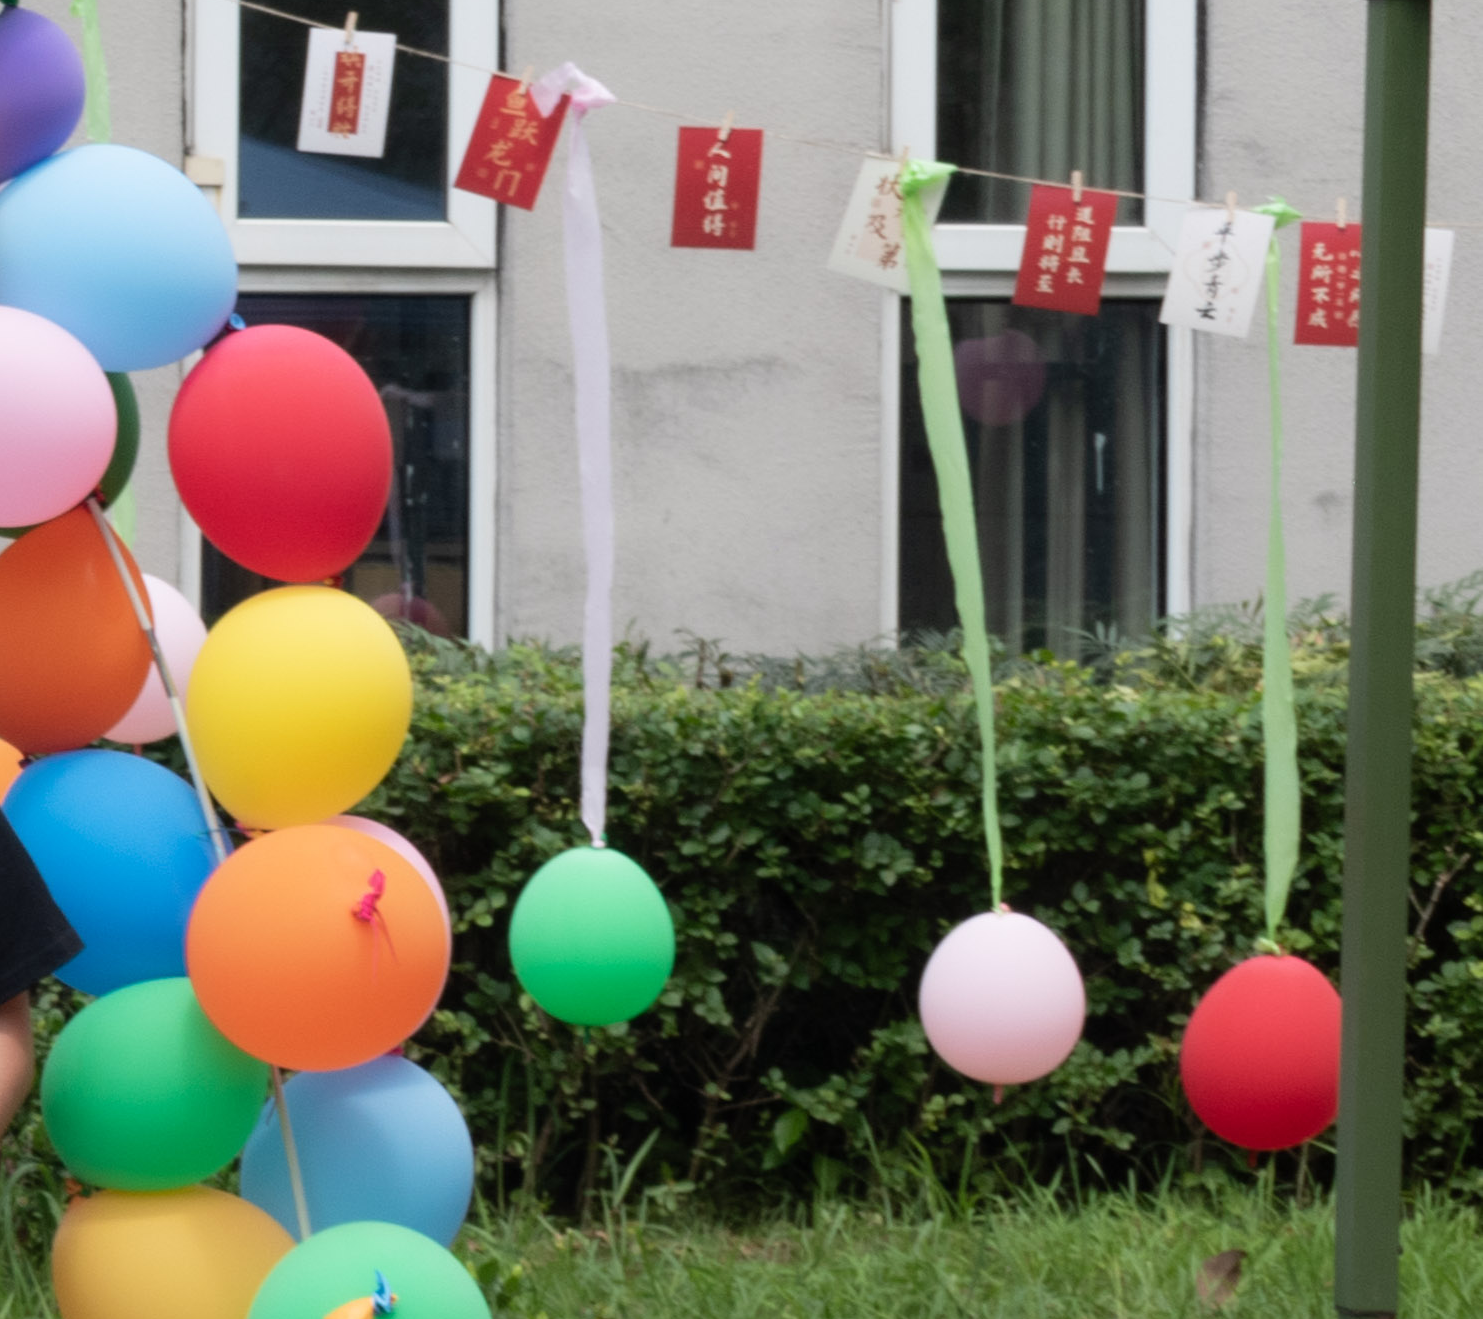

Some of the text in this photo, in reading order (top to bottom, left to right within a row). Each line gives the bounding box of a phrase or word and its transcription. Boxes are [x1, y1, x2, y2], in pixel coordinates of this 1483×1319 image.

[483, 89, 539, 198] 鱼跃龙门
[703, 141, 733, 237] 人间值得
